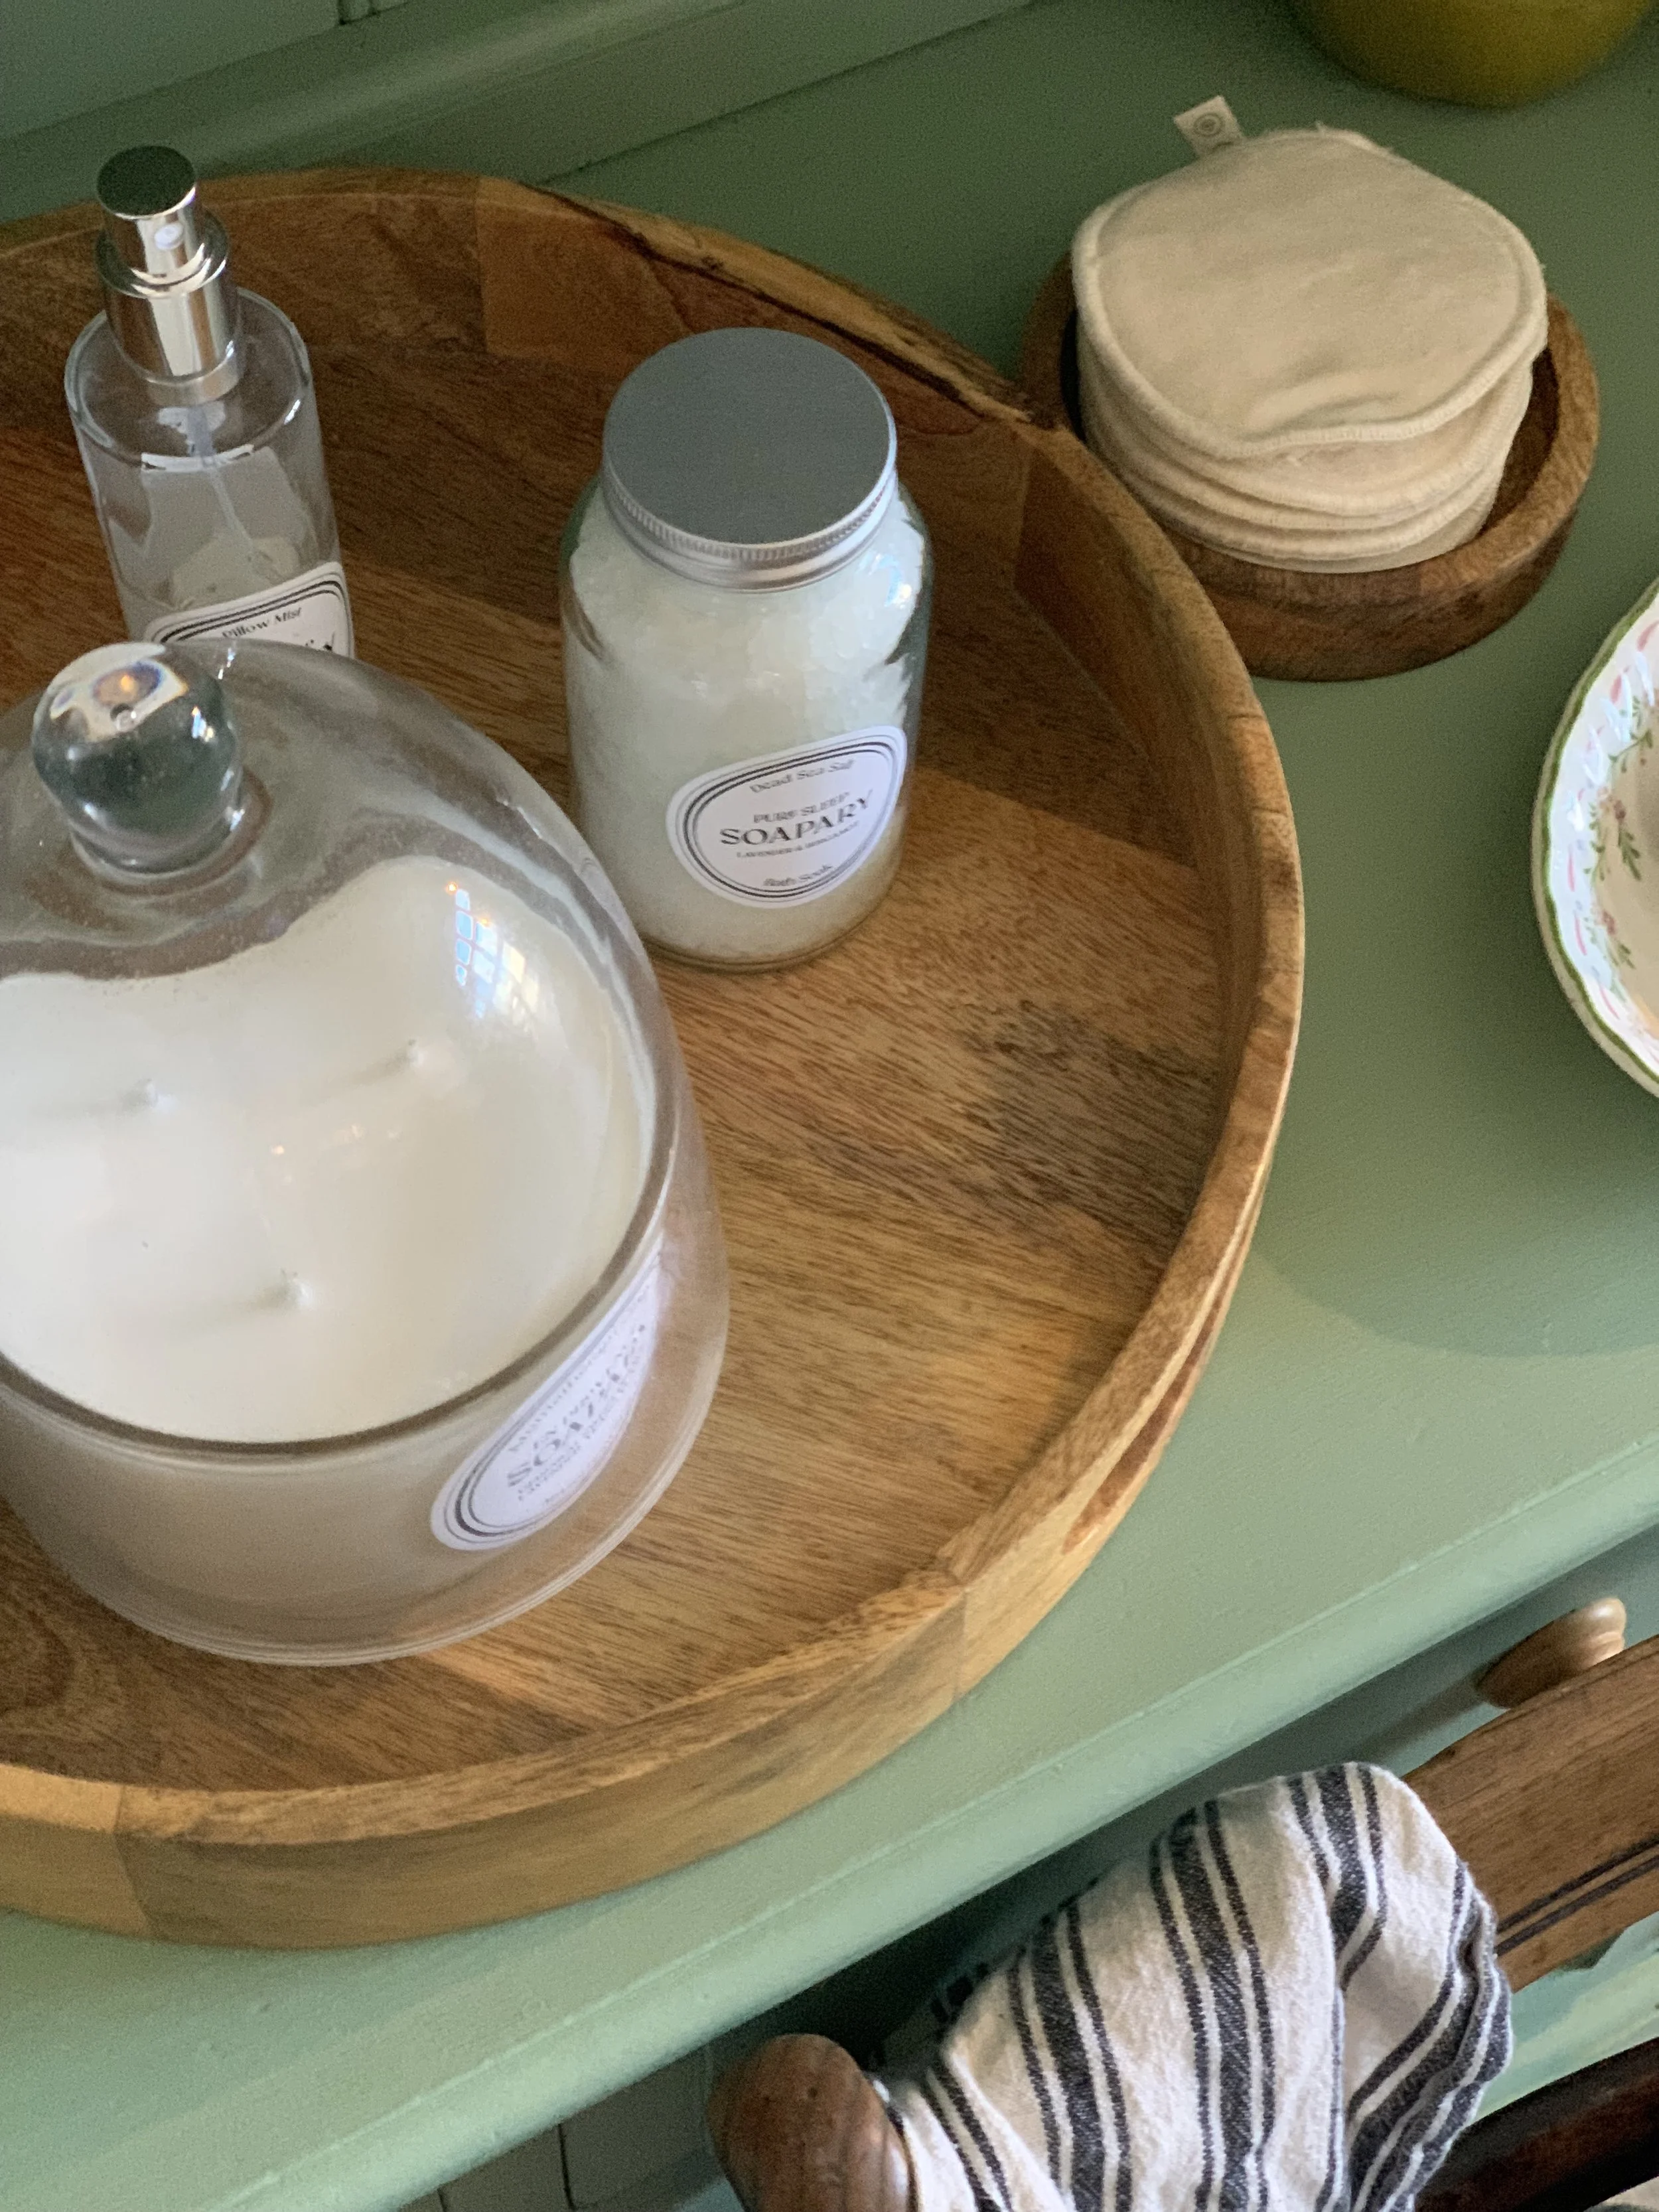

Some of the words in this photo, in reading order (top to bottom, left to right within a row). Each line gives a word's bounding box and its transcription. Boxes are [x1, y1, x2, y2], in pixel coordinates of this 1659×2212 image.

[221, 620, 269, 638] Pillow
[273, 607, 302, 625] Mist
[749, 773, 792, 793] Dead
[796, 768, 825, 780] Sea
[719, 789, 873, 846] SOAPARY
[753, 809, 797, 824] PURE
[800, 791, 849, 816] SLEEP
